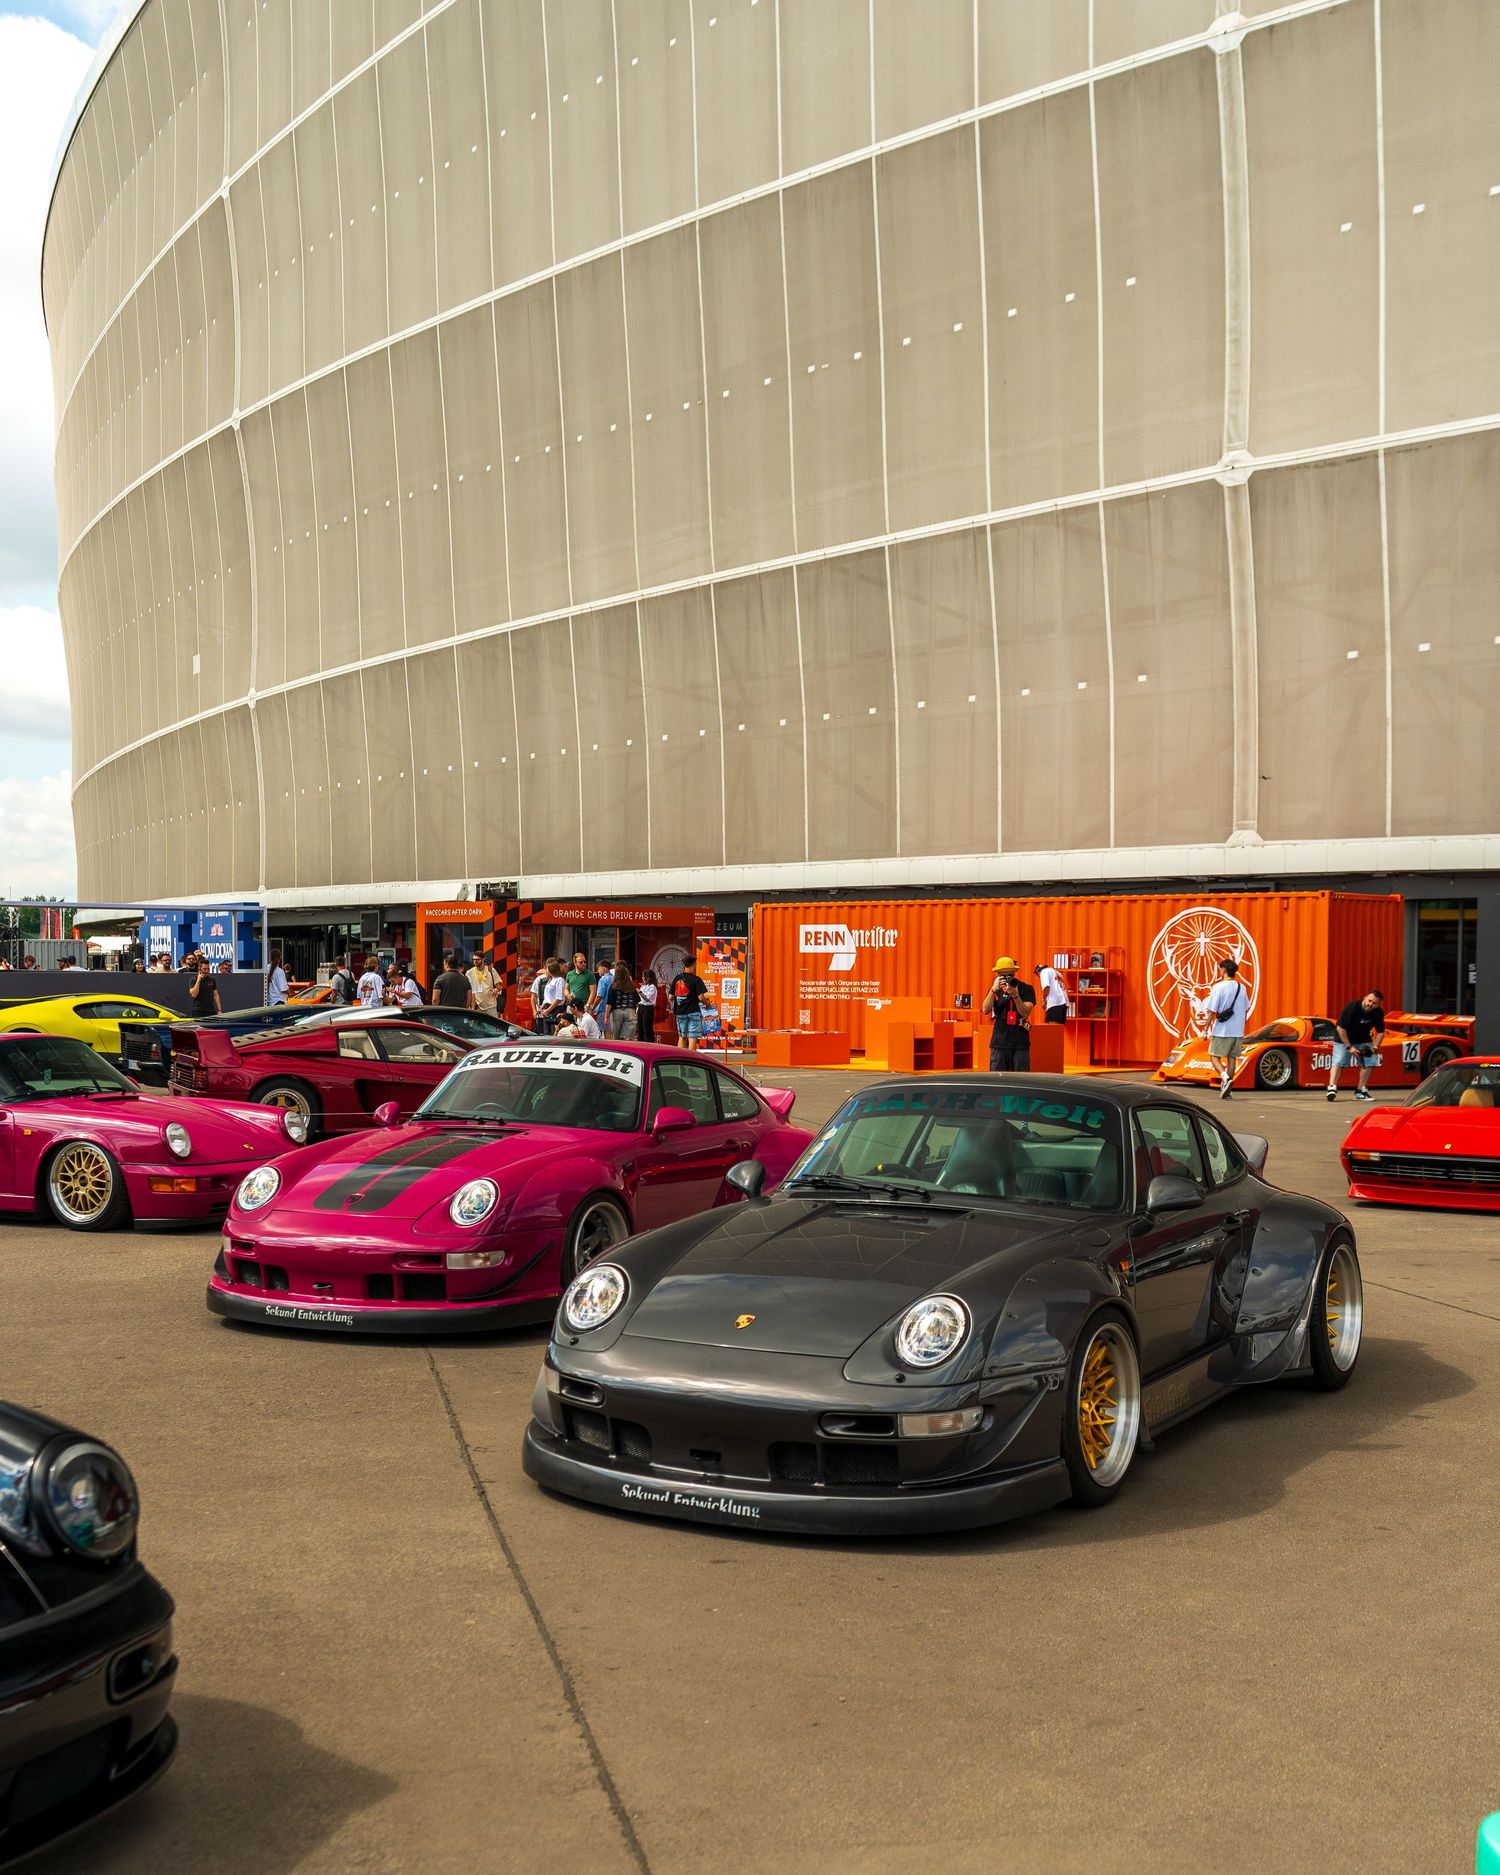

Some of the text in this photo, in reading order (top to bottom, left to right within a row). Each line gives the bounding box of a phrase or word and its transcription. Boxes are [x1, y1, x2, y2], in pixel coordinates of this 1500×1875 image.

[468, 908, 483, 916] DARK
[553, 909, 663, 920] ORANGE CARS DRIVE FASTER
[716, 922, 743, 931] ZEUM
[804, 930, 845, 946] RENN
[1404, 1042, 1419, 1061] 16
[458, 1050, 634, 1075] RAUH-Welt
[264, 1305, 353, 1326] Sekund Entwicklung
[621, 1484, 761, 1518] Sekund Entwicklung
